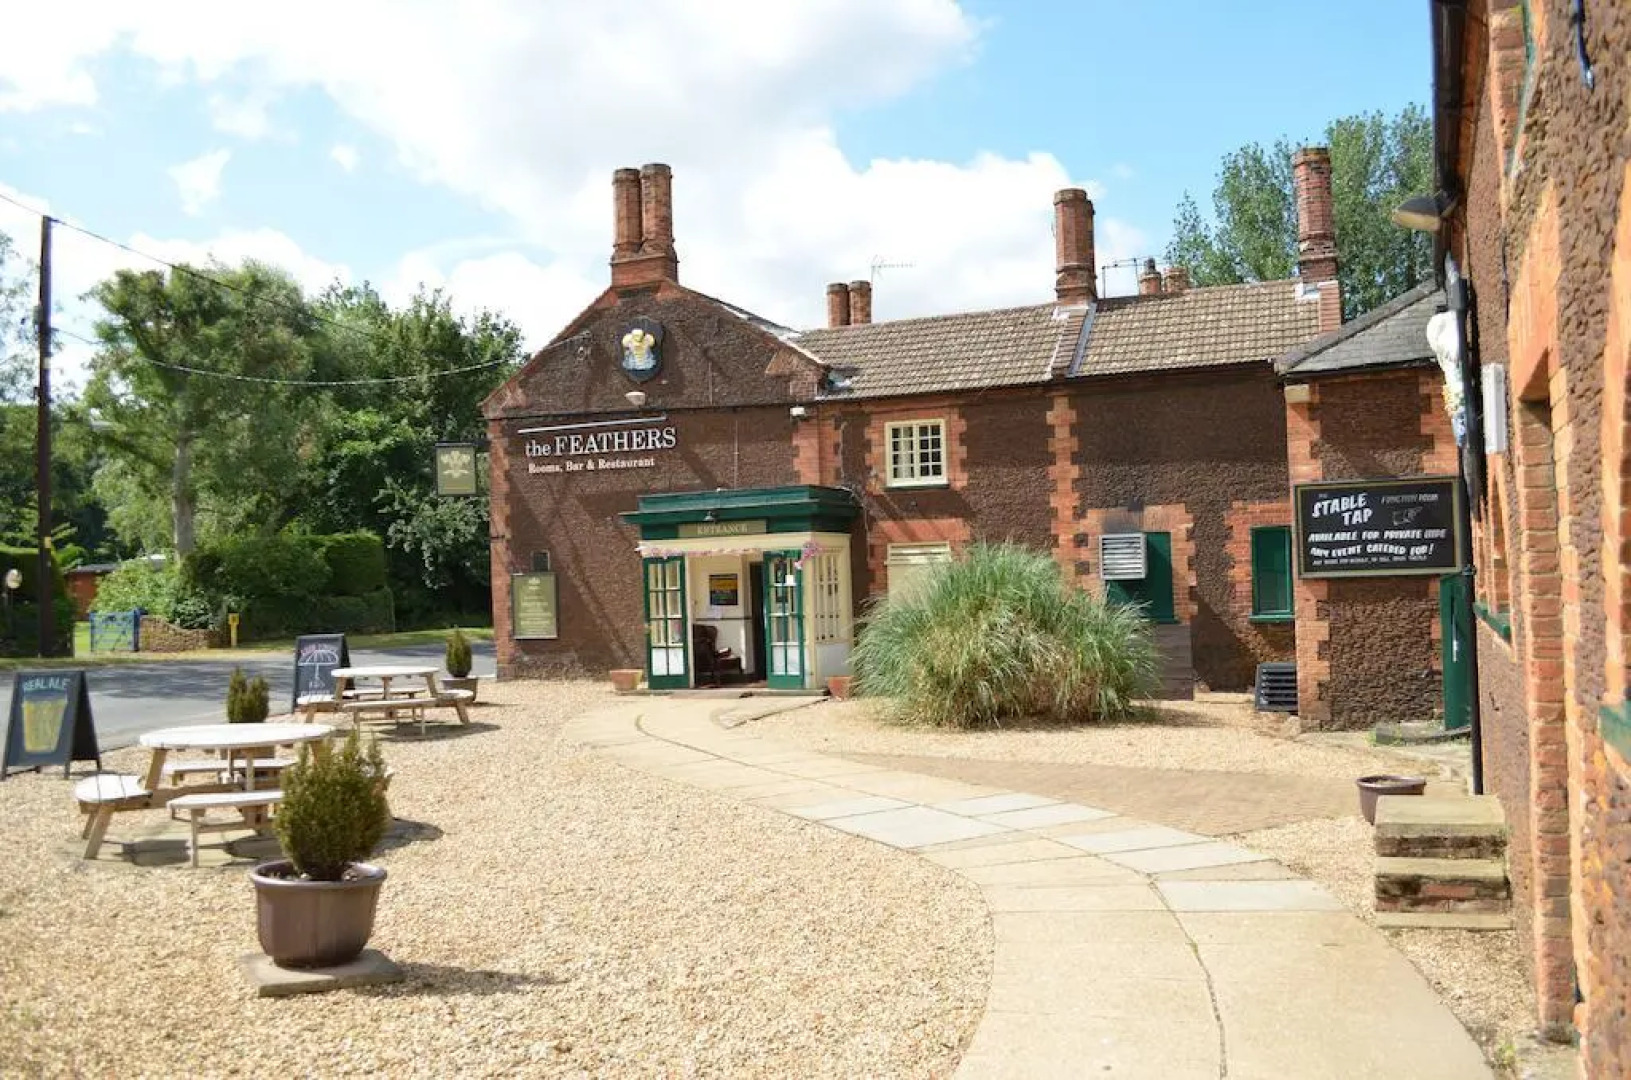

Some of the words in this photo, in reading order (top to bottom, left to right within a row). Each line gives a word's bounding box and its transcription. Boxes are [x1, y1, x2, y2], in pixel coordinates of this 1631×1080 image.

[525, 440, 550, 457] the
[554, 427, 676, 456] FEATHERS
[528, 463, 562, 473] Rooms,
[566, 460, 584, 471] Bar
[586, 459, 595, 470] &
[598, 457, 655, 469] Restaurant
[1419, 493, 1439, 502] ROOM
[1312, 493, 1367, 518] STABLE
[1342, 508, 1373, 526] TAP
[697, 523, 748, 535] ENTRANCE
[1308, 530, 1357, 542] AVAILABLE
[1362, 530, 1380, 540] FOR
[1384, 529, 1422, 539] PRIVATE
[1424, 528, 1447, 539] HIRE
[1310, 547, 1330, 557] ANY
[1331, 545, 1362, 557] EVENT
[1366, 543, 1406, 555] CATERED
